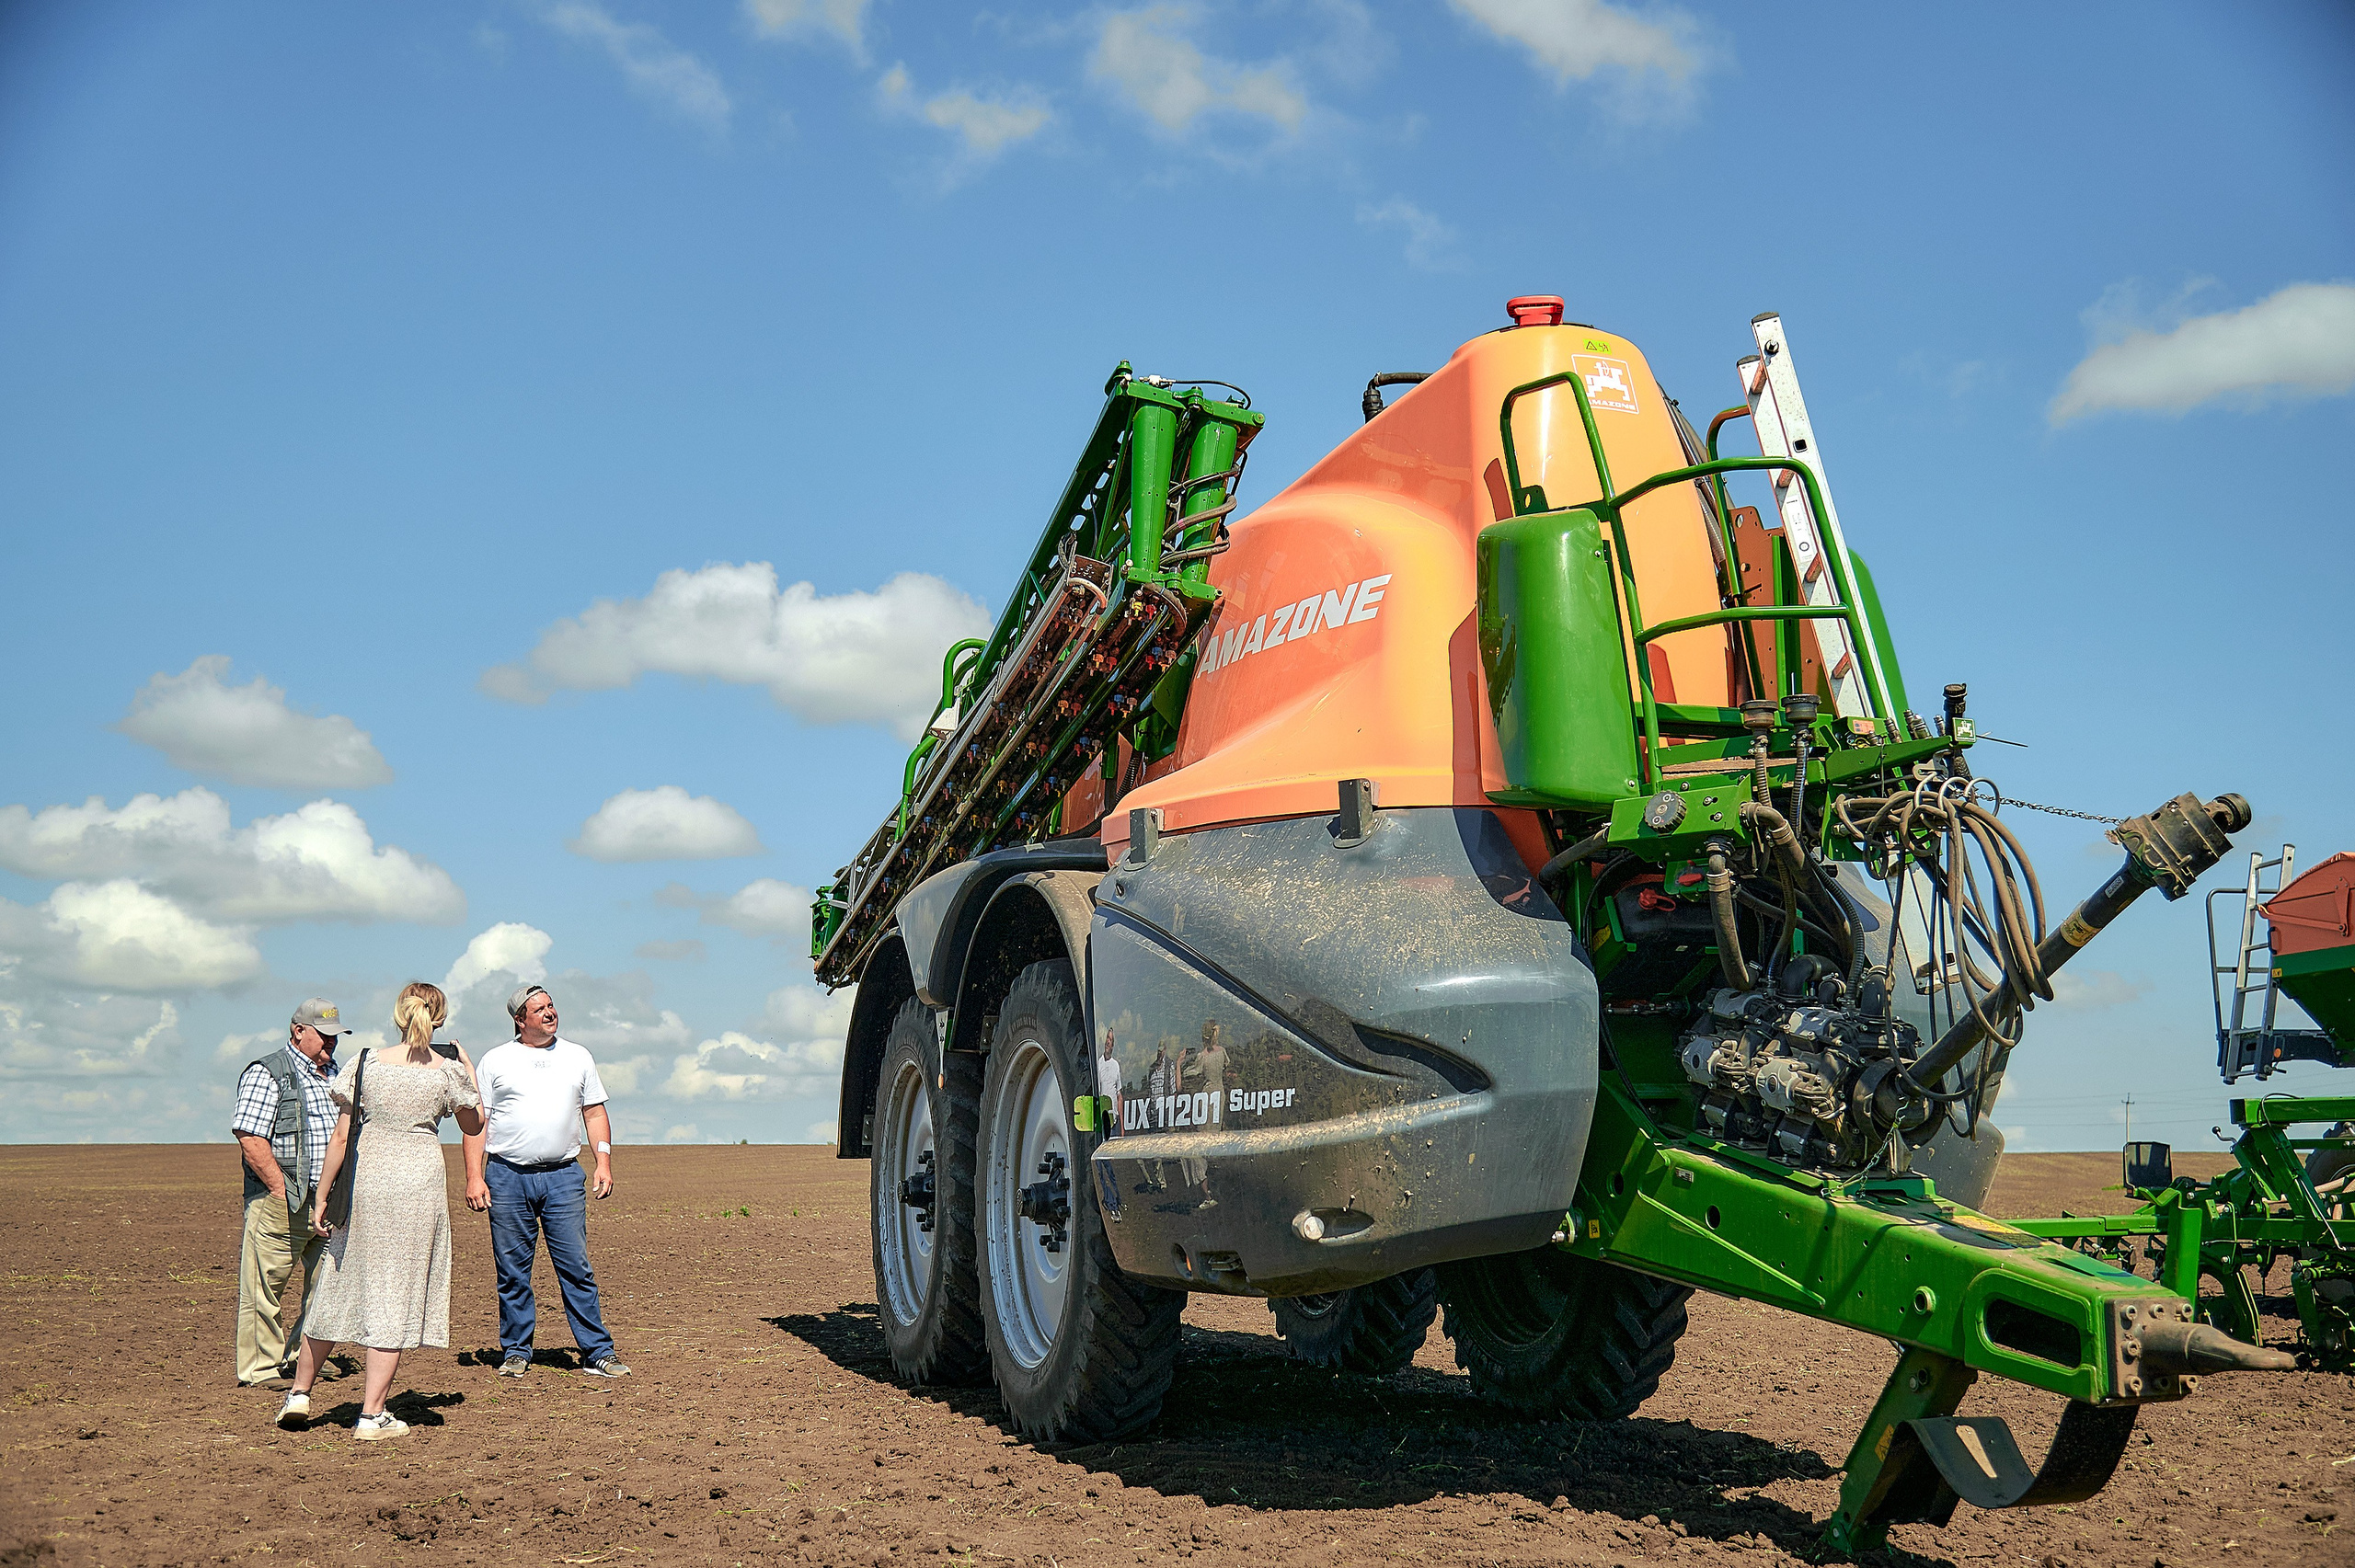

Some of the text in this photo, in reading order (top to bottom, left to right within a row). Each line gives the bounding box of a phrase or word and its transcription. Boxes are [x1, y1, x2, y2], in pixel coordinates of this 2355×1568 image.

[1197, 574, 1393, 679] AMAZONE
[1123, 1088, 1295, 1131] UX 11201 Super
